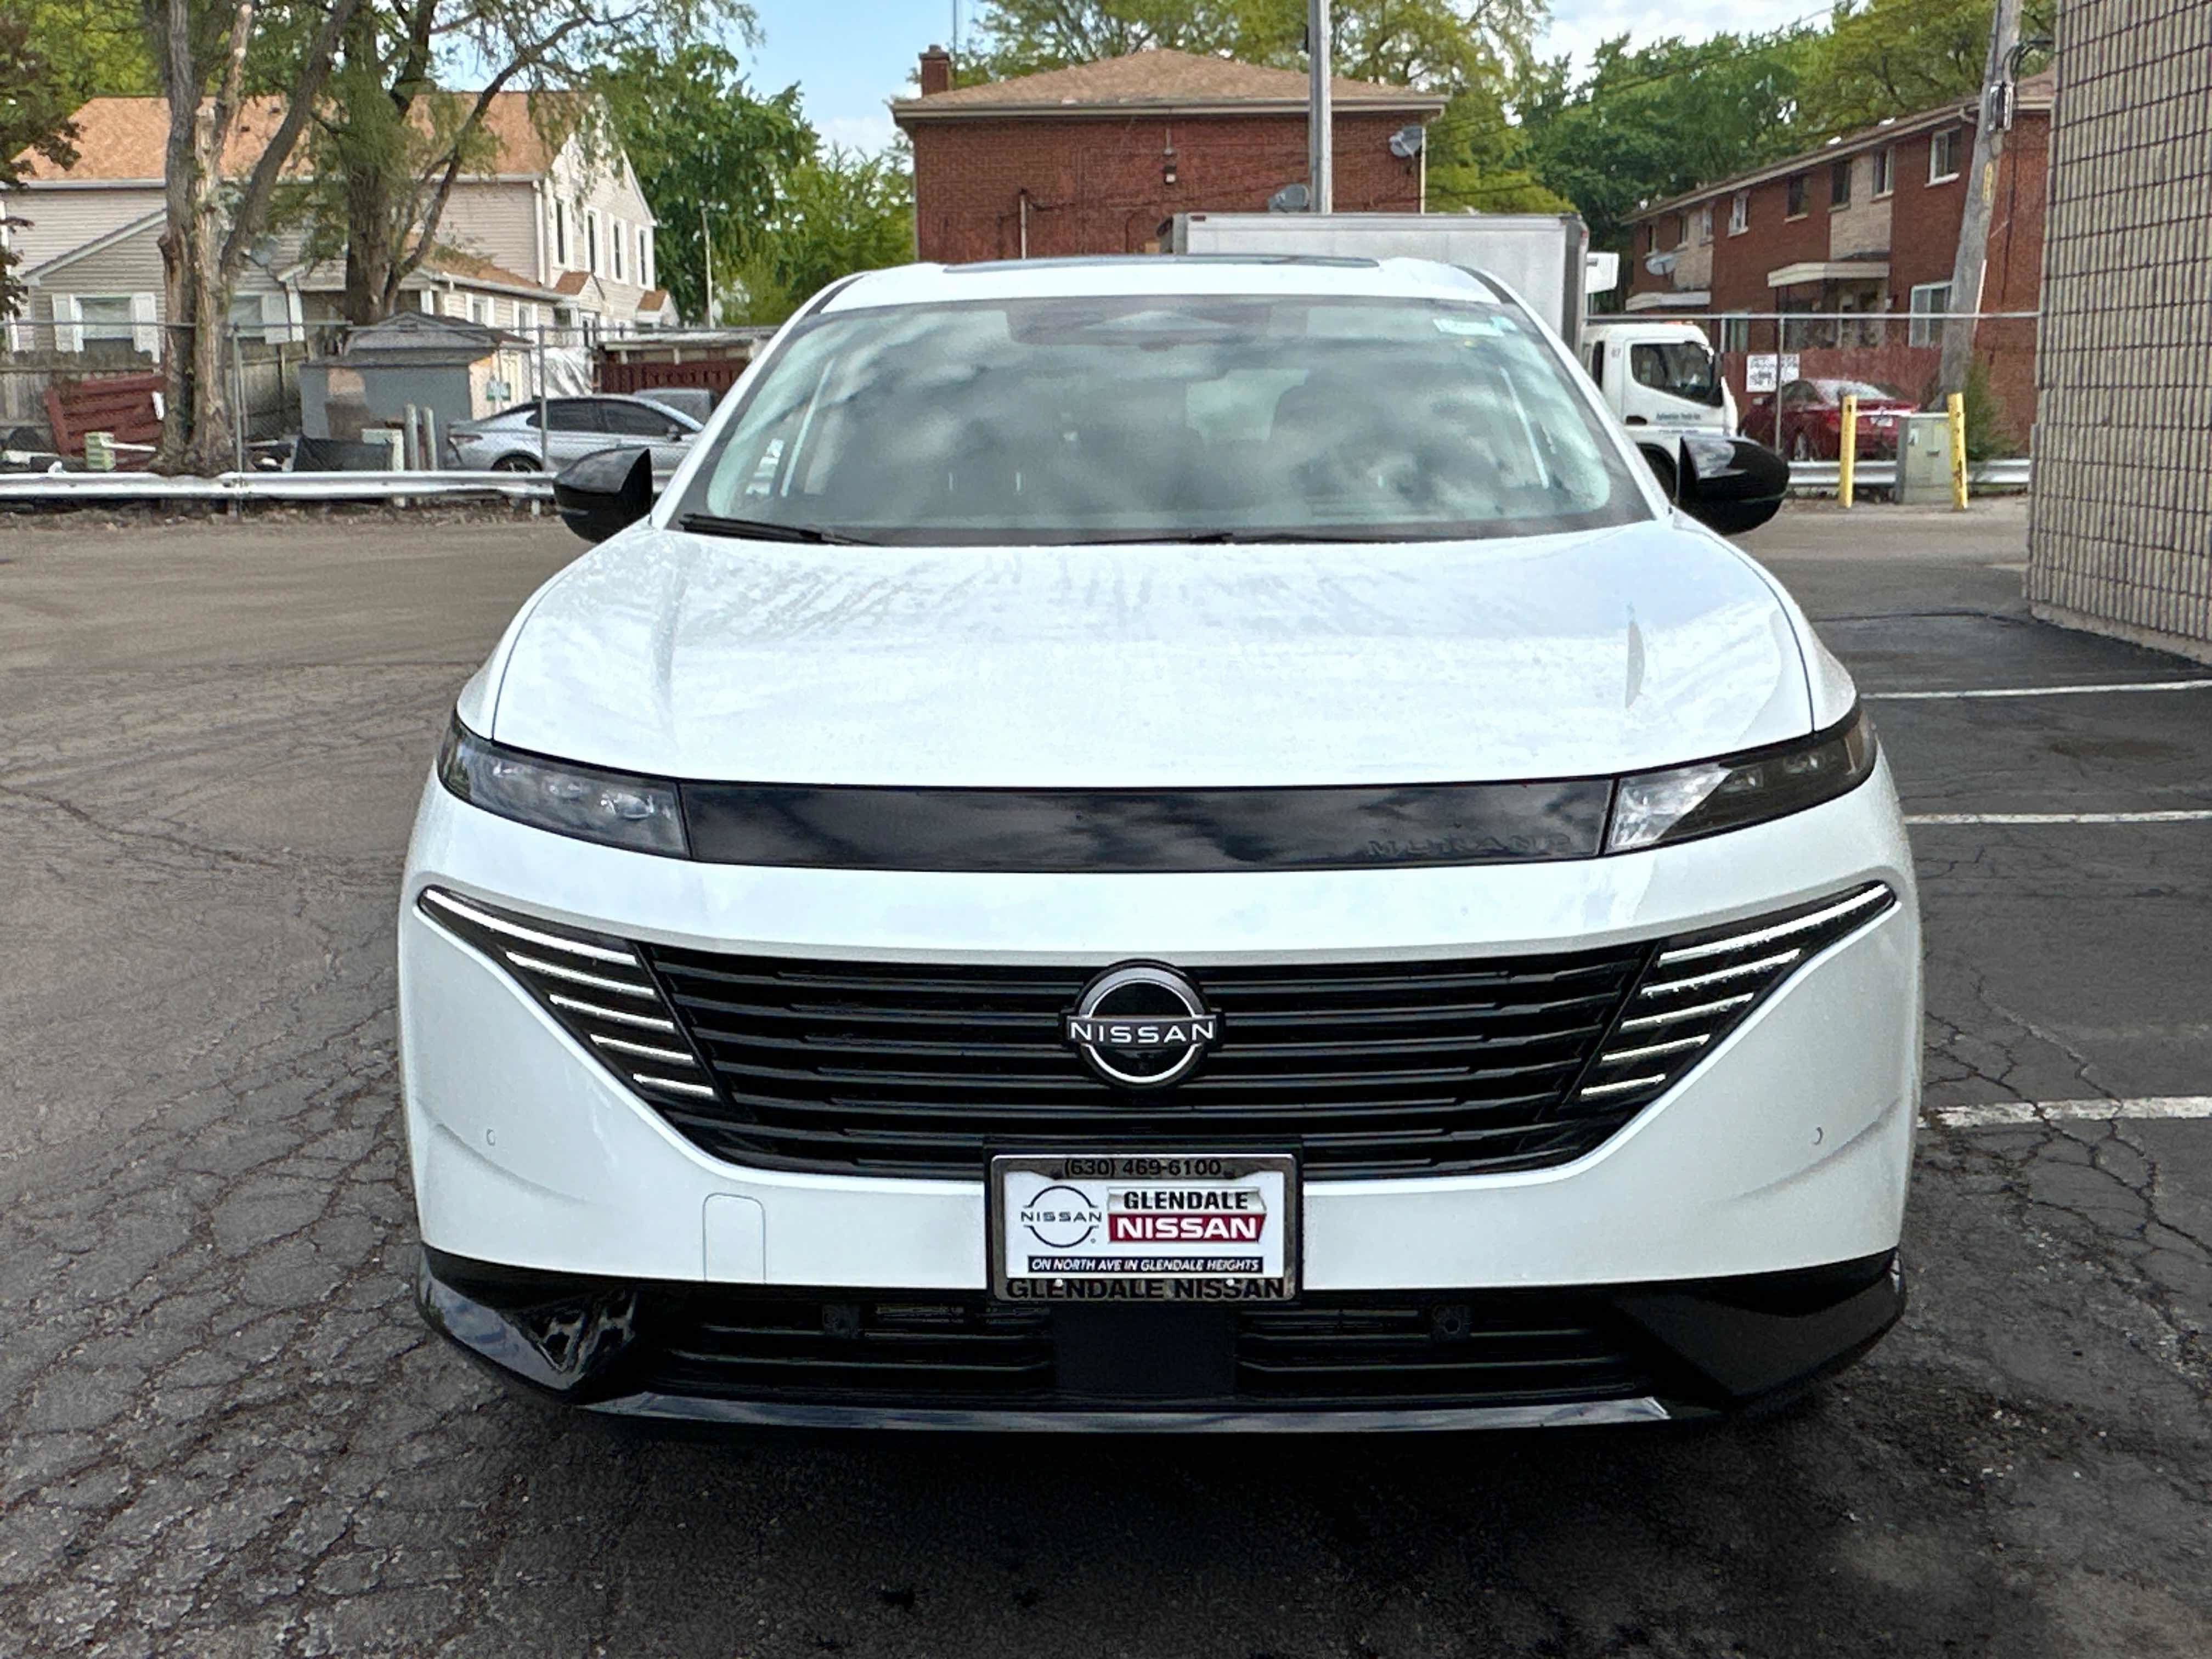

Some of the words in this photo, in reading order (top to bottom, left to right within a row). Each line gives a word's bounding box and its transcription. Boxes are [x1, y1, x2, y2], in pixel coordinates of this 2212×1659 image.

[1368, 832, 1572, 856] MURANO
[1070, 1021, 1214, 1043] NISSAN
[1064, 1159, 1115, 1176] (630)
[1122, 1159, 1221, 1175] 469-6100
[1124, 1191, 1248, 1210] GLENDALE
[1020, 1211, 1102, 1222] NISSAN
[1116, 1217, 1256, 1239] NISSAN
[1032, 1259, 1051, 1270] ON
[1053, 1259, 1096, 1270] NORTH
[1097, 1259, 1122, 1271] AVE
[1124, 1259, 1138, 1271] IN
[1141, 1259, 1204, 1271] GLENDALE
[1207, 1259, 1260, 1271] HEIGHTS
[1006, 1278, 1165, 1299] GLENDALE
[1174, 1278, 1284, 1299] NISSAN
